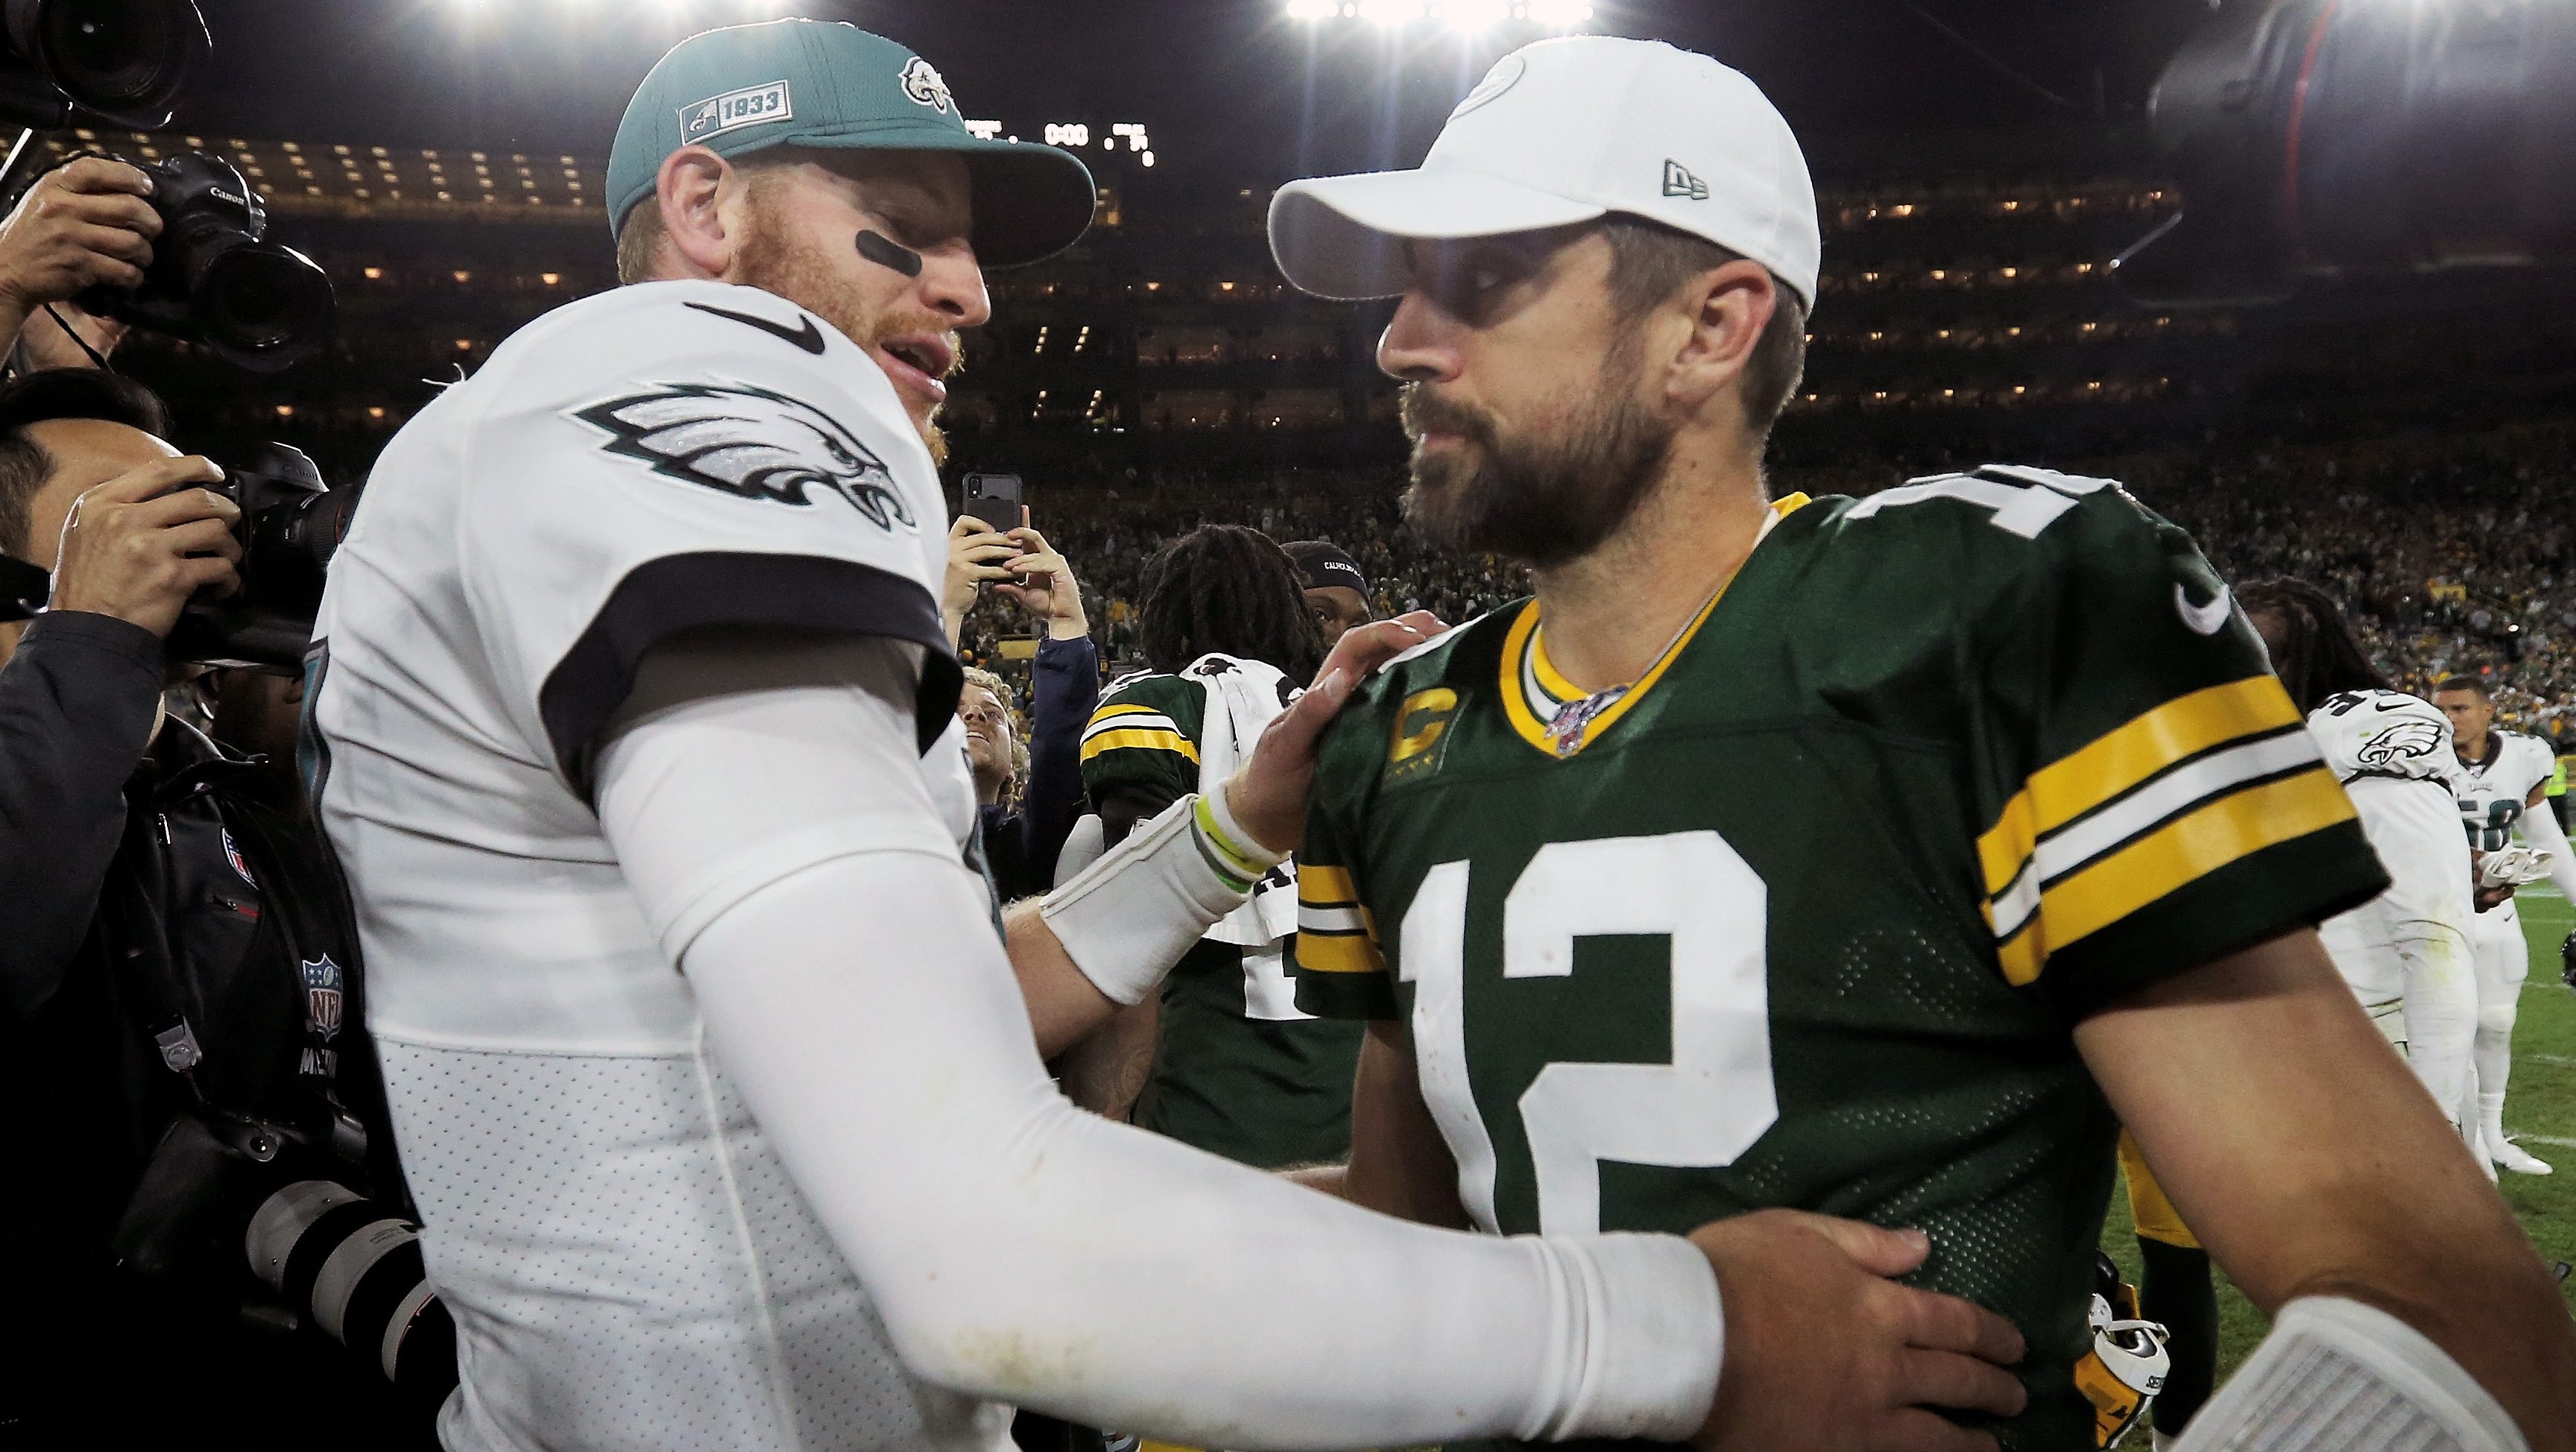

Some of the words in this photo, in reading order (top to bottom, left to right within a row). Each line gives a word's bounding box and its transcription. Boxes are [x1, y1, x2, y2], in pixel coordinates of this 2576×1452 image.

[724, 90, 779, 119] 1933
[1044, 123, 1088, 146] 0:00
[210, 186, 244, 206] Canon
[1390, 686, 1458, 763] C
[1399, 830, 1779, 1237] 12
